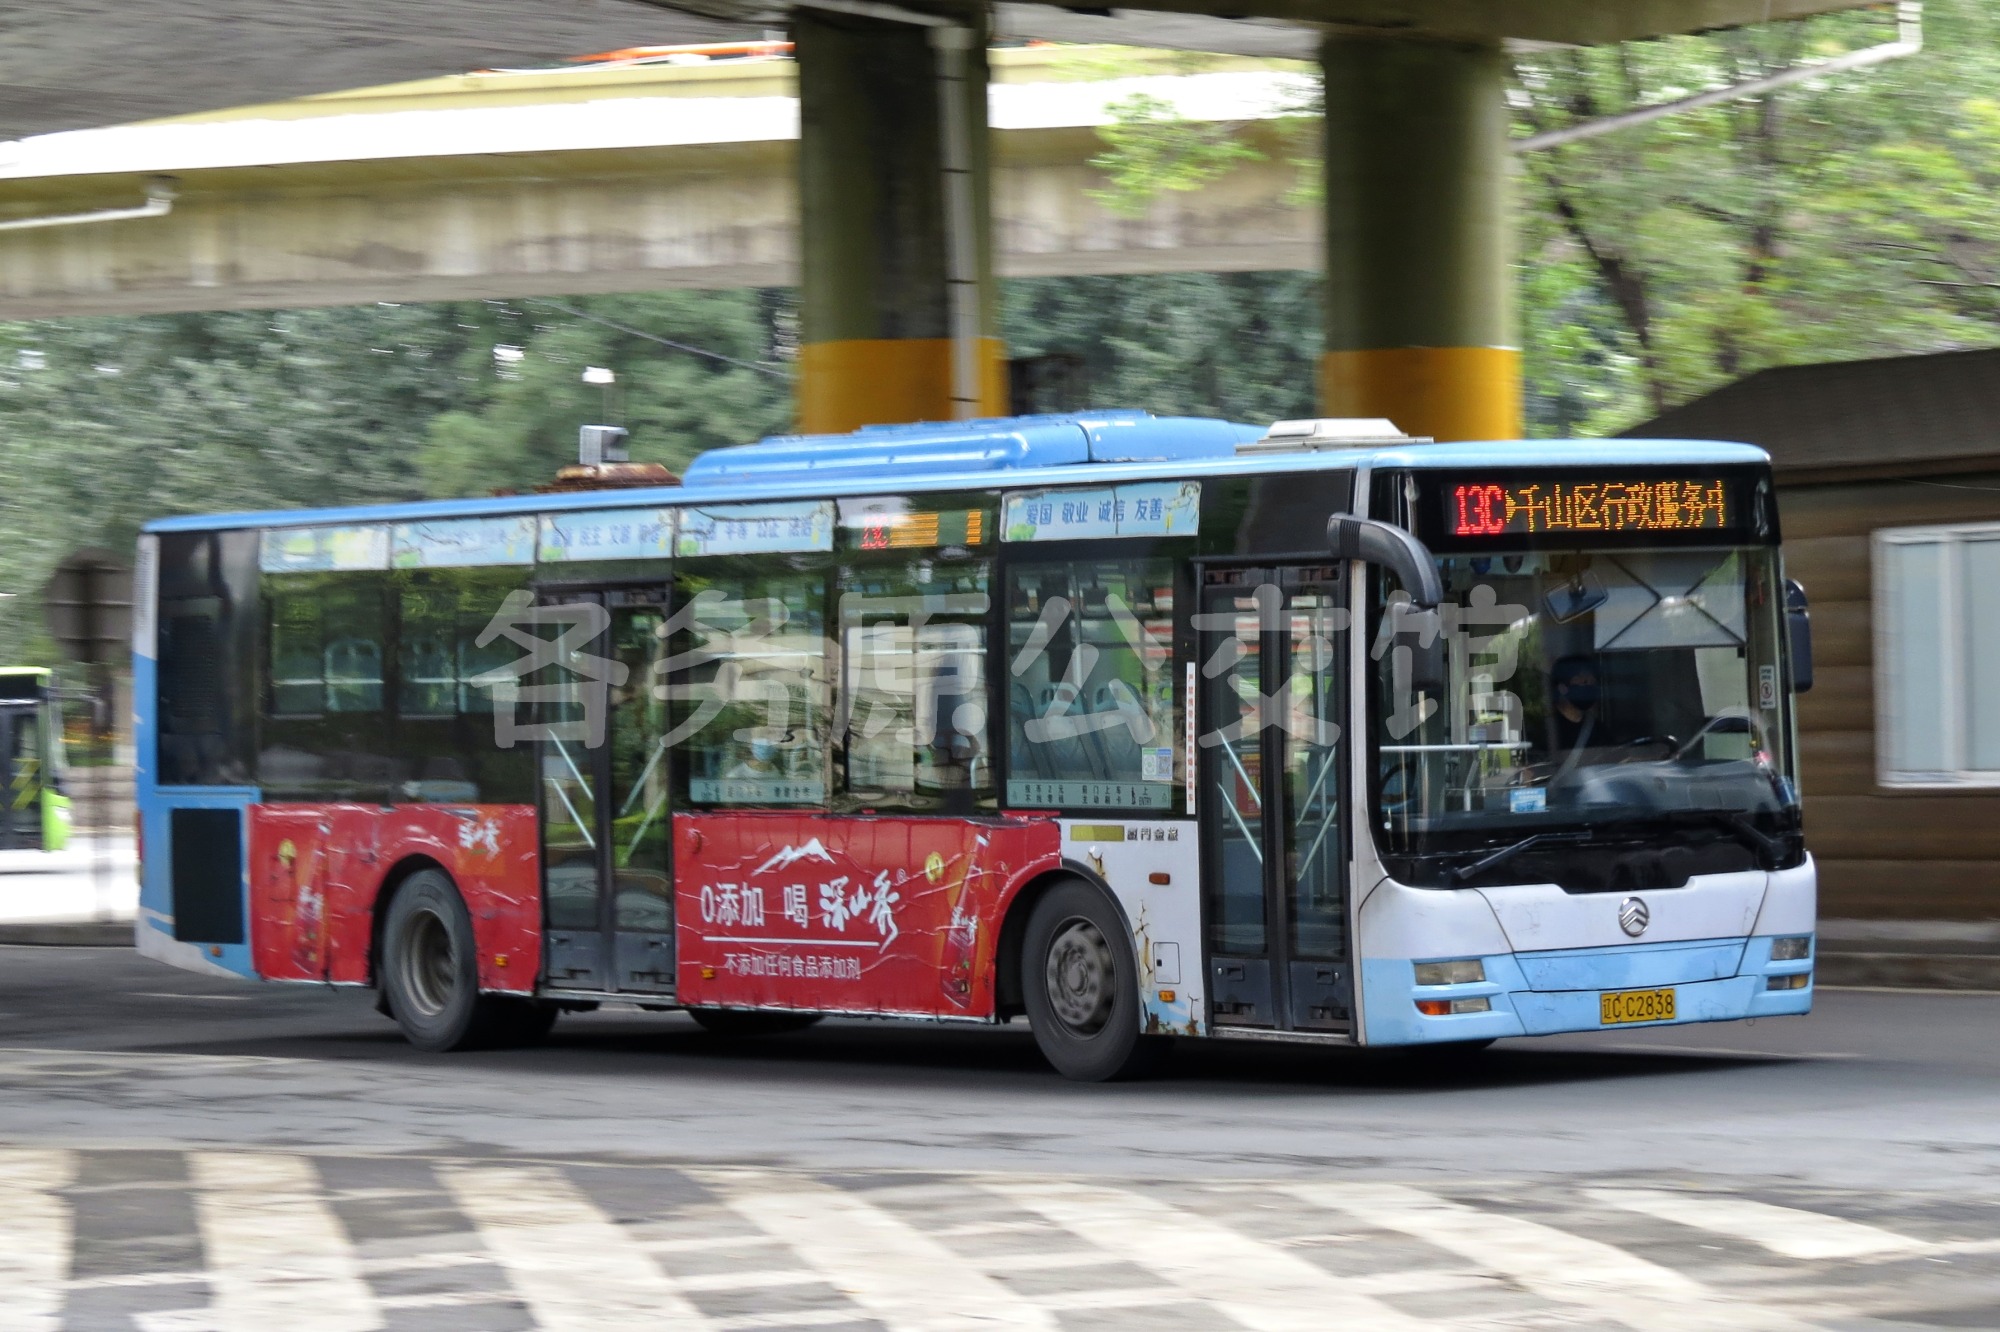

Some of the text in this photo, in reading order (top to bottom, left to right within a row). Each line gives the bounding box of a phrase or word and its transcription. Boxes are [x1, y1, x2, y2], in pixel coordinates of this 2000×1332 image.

[1026, 498, 1163, 526] 爱国 敬业 诚信 友善
[701, 882, 765, 927] 0添加
[783, 884, 809, 929] 喝
[723, 952, 861, 980] 不添加任何食品添加剂
